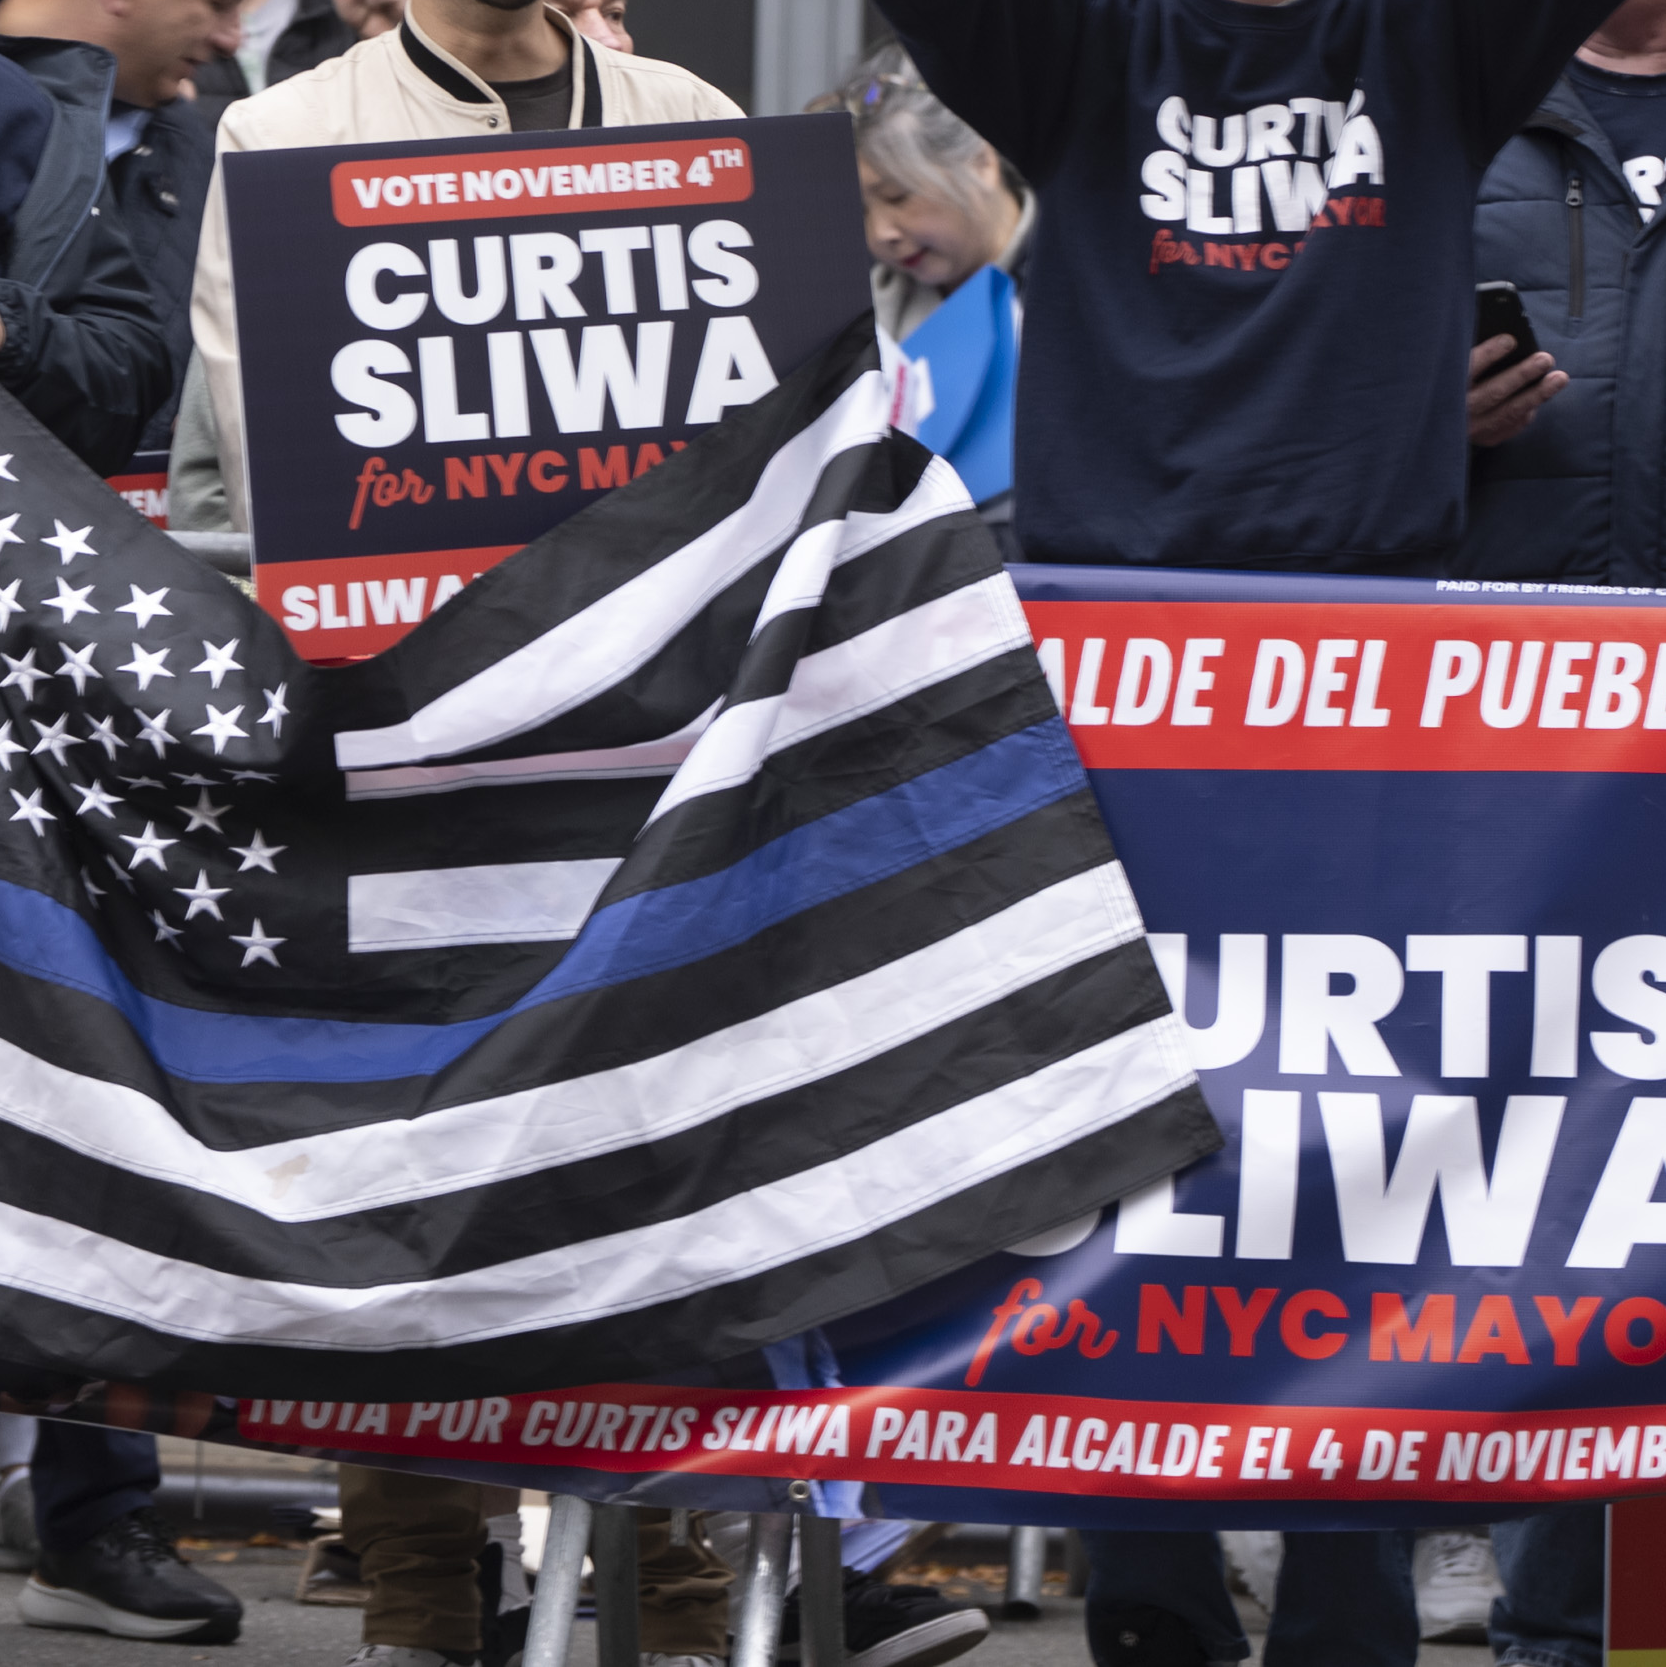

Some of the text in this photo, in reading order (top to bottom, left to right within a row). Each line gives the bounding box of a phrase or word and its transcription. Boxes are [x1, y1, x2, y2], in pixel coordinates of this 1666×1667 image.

[351, 148, 744, 209] VOTE NOVEMBER 4TH
[1140, 114, 1385, 234] SLIWA
[345, 218, 760, 332] CURTIS
[1203, 241, 1291, 272] NYC
[330, 315, 781, 449] SLIWA
[348, 456, 435, 530] for
[443, 450, 568, 501] NYC
[1244, 637, 1391, 729] DEL
[964, 1276, 1120, 1388] for
[1136, 1282, 1350, 1360] NYC
[403, 1397, 512, 1442] POR
[521, 1400, 696, 1452] CURTIS
[701, 1404, 851, 1459] SLIWA
[864, 1408, 999, 1465] PARA
[1008, 1413, 1231, 1479] ALCALDE
[1239, 1425, 1294, 1481] EL
[1308, 1428, 1343, 1481] 4
[1356, 1430, 1427, 1483] DE
